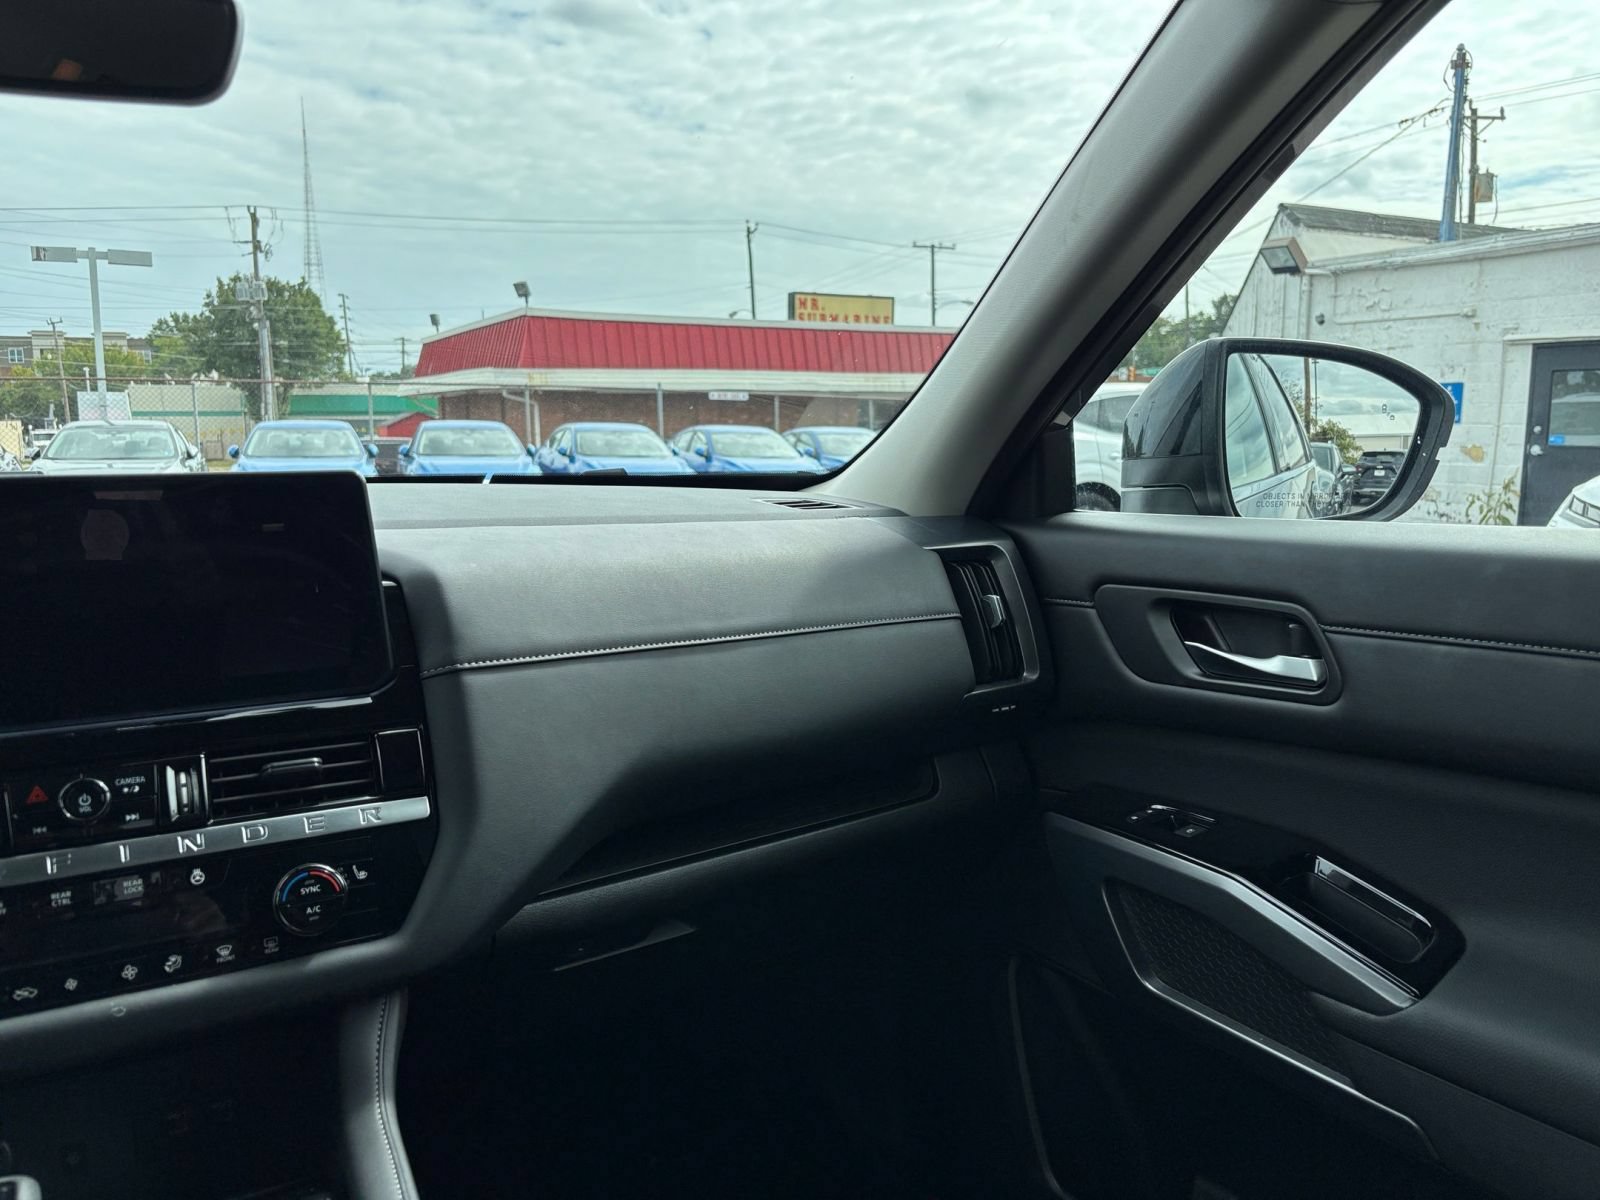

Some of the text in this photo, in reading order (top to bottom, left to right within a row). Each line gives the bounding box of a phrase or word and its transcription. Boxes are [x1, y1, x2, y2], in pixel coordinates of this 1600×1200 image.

[798, 312, 891, 324] SUBMARINE
[1262, 492, 1295, 500] OBJECTS
[1255, 500, 1284, 508] CLOSER
[1286, 500, 1306, 508] THAN
[115, 776, 146, 786] CAMERA
[123, 879, 143, 887] REAR
[124, 886, 143, 895] LOCK
[300, 884, 321, 895] SYNC
[51, 890, 71, 899] REAR
[51, 898, 71, 907] CTRL
[306, 905, 321, 914] A/C
